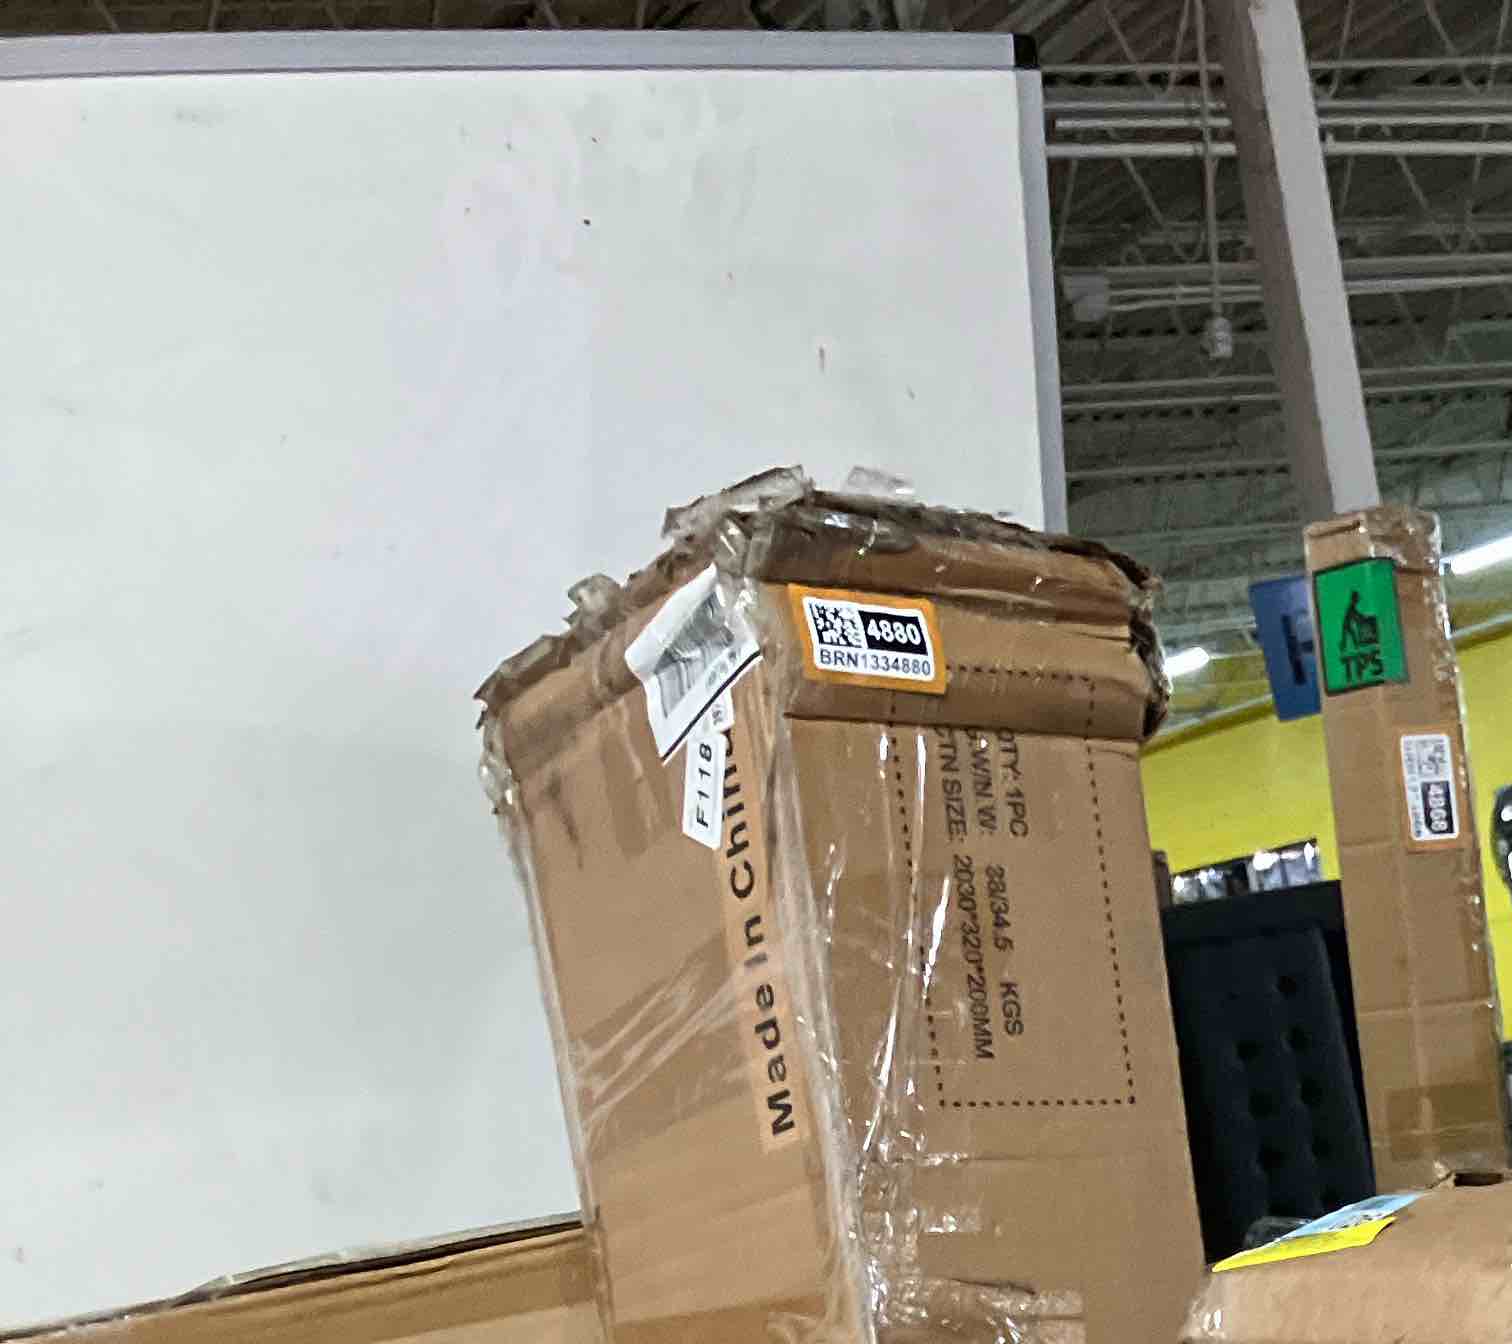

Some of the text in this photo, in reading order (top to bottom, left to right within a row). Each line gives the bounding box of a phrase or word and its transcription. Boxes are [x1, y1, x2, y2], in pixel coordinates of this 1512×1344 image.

[866, 619, 923, 646] 4880
[820, 650, 931, 676] BRN1334880
[1005, 790, 1028, 838] 1PC
[743, 912, 773, 975] In
[1000, 981, 1025, 1037] KGS
[754, 984, 796, 1135] Made
